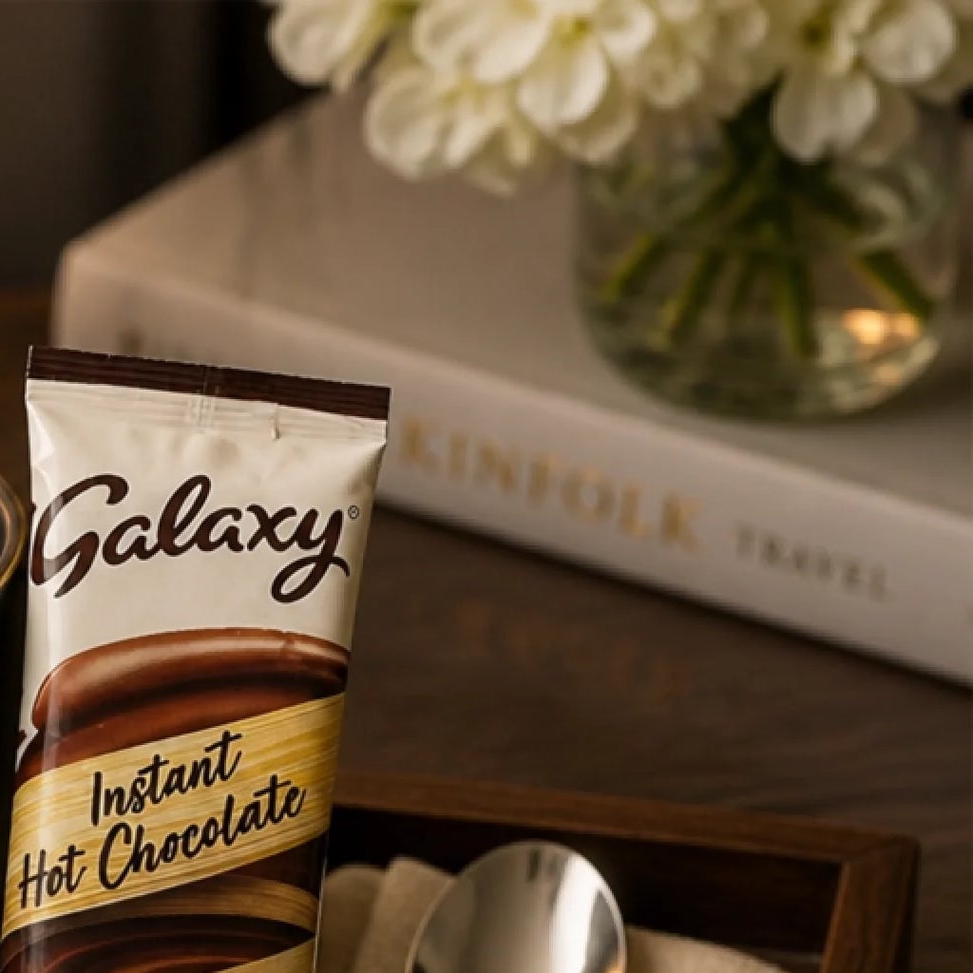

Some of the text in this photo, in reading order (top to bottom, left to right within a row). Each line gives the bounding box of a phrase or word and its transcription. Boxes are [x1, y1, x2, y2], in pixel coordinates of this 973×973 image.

[31, 473, 350, 603] Galaxy
[399, 418, 705, 554] KINFOLK
[18, 774, 306, 909] Hot Chocolate
[90, 730, 242, 827] Instant
